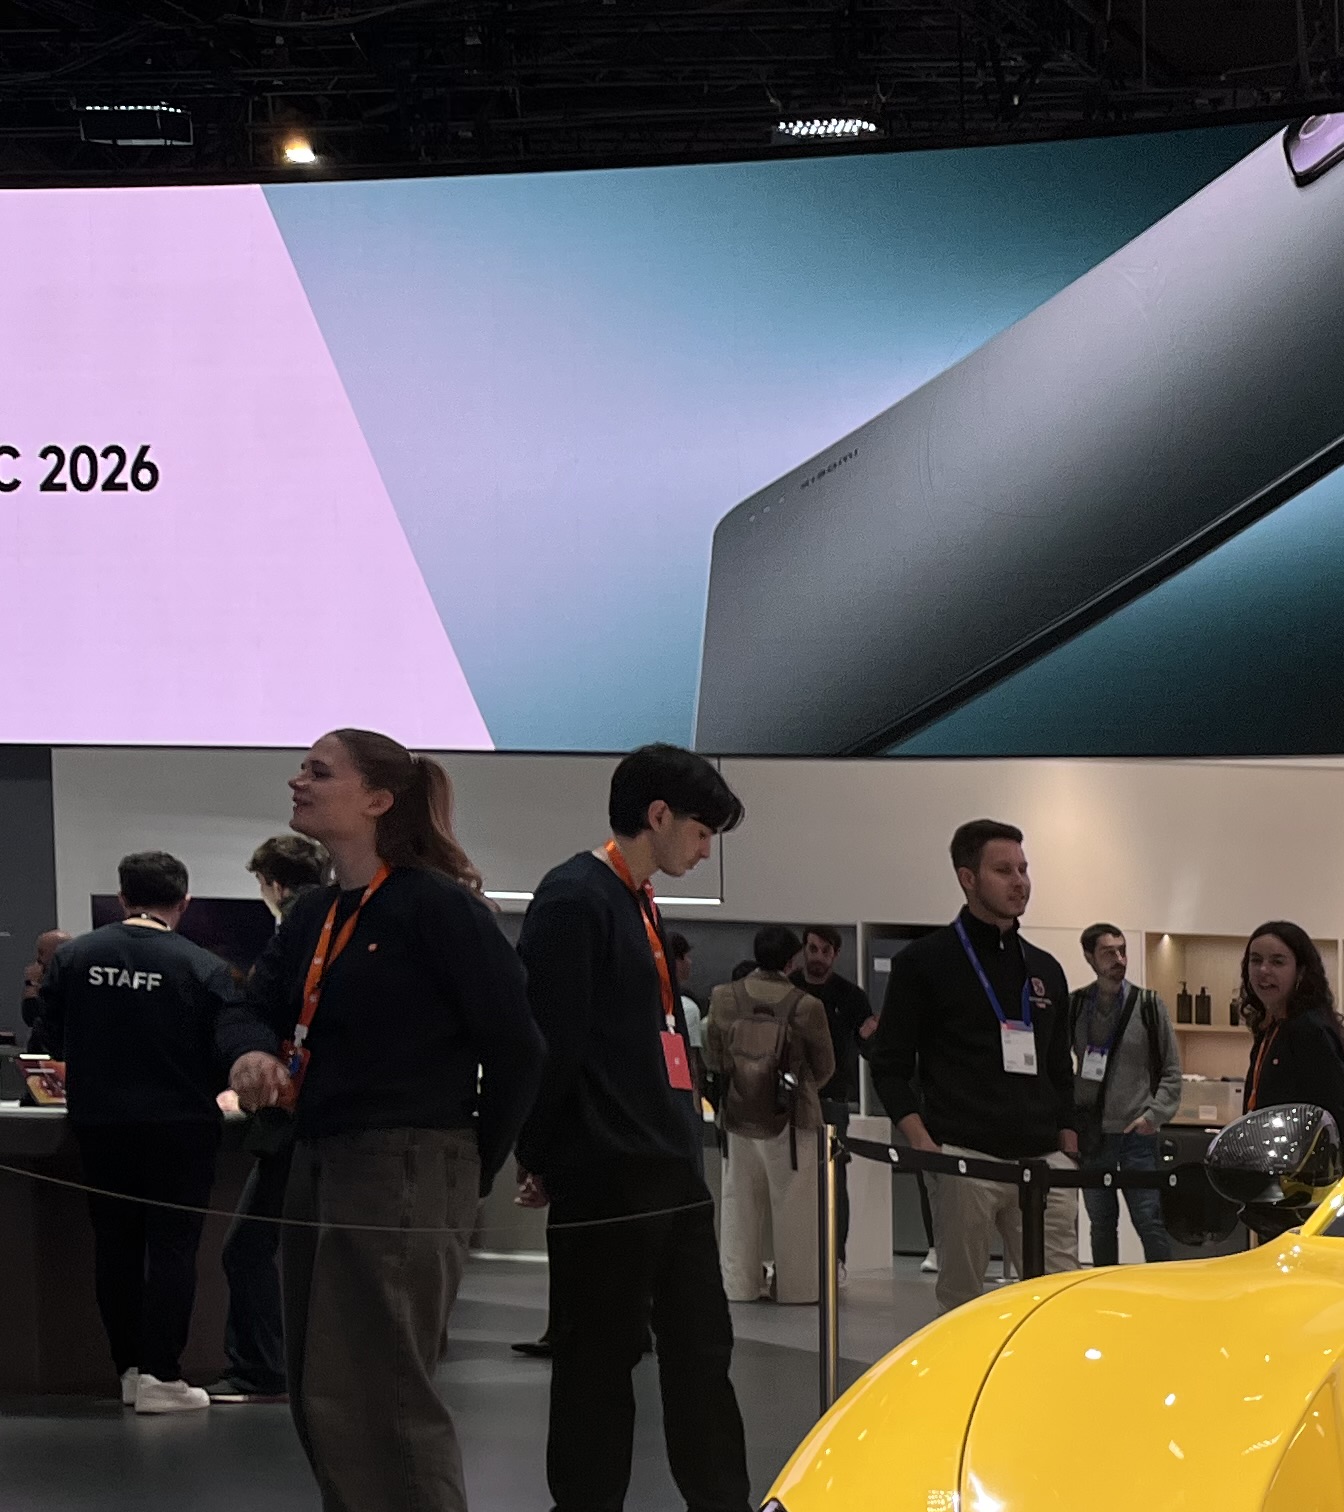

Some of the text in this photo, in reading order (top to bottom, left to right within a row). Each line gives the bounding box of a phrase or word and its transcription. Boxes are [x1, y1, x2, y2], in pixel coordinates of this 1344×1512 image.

[0, 445, 160, 492] C 2026
[88, 965, 163, 992] STAFF
